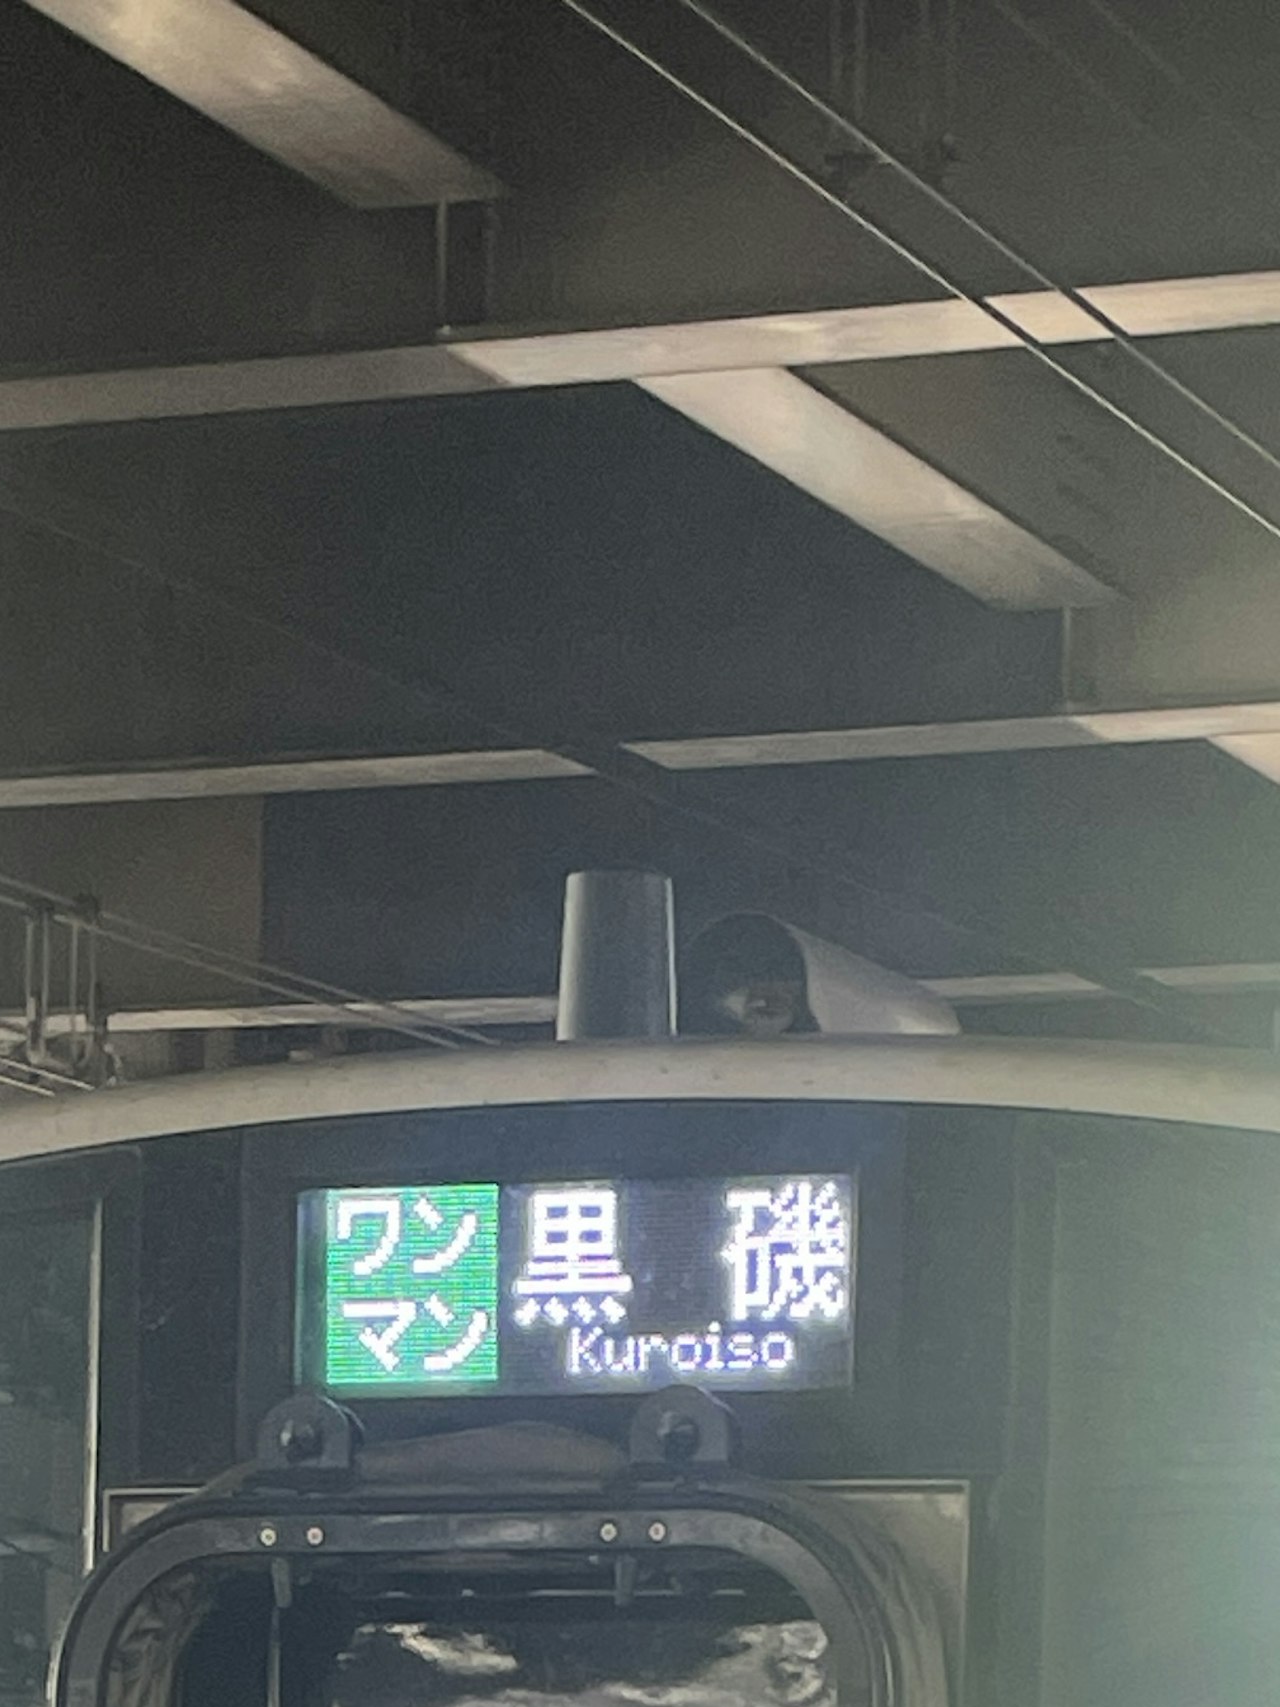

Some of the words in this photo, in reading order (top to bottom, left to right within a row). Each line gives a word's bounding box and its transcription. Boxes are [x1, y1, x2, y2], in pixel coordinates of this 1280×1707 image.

[336, 1196, 478, 1276] ワン
[340, 1292, 489, 1372] マン
[565, 1321, 795, 1373] Kuroiso
